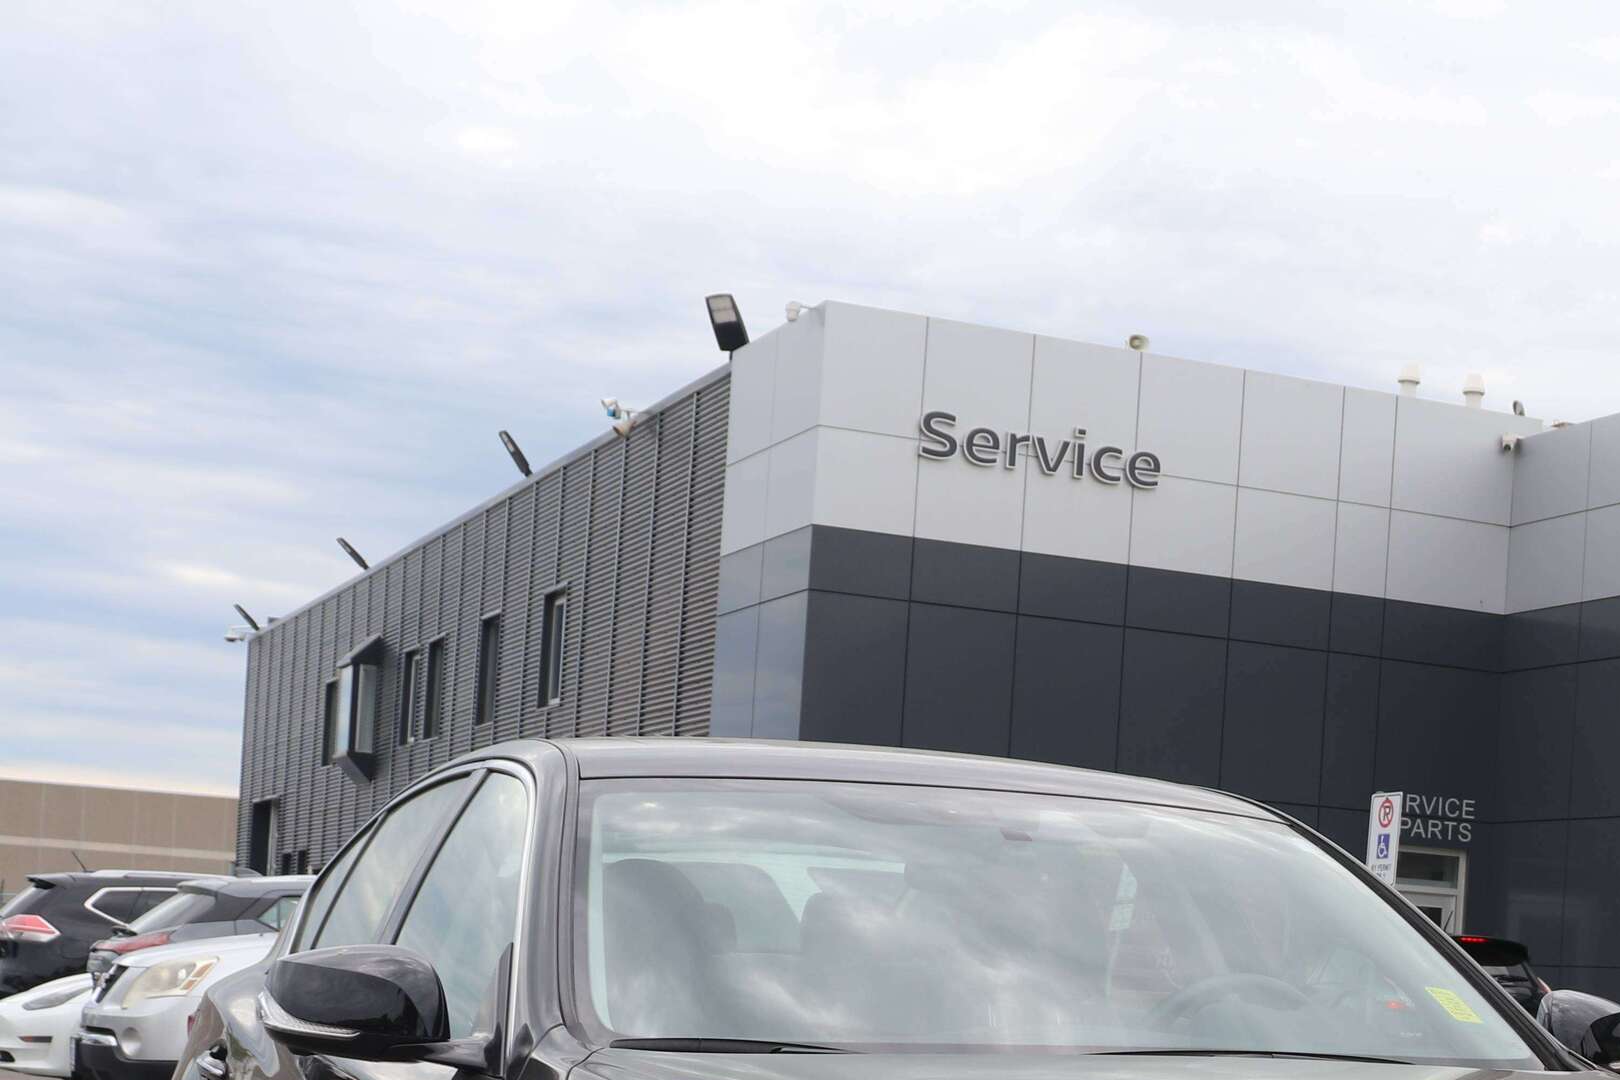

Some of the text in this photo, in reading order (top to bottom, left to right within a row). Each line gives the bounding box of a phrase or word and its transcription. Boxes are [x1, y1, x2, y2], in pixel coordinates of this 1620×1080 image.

[918, 410, 1162, 489] Service
[1405, 793, 1476, 820] RVICE
[1399, 817, 1472, 843] PARTS
